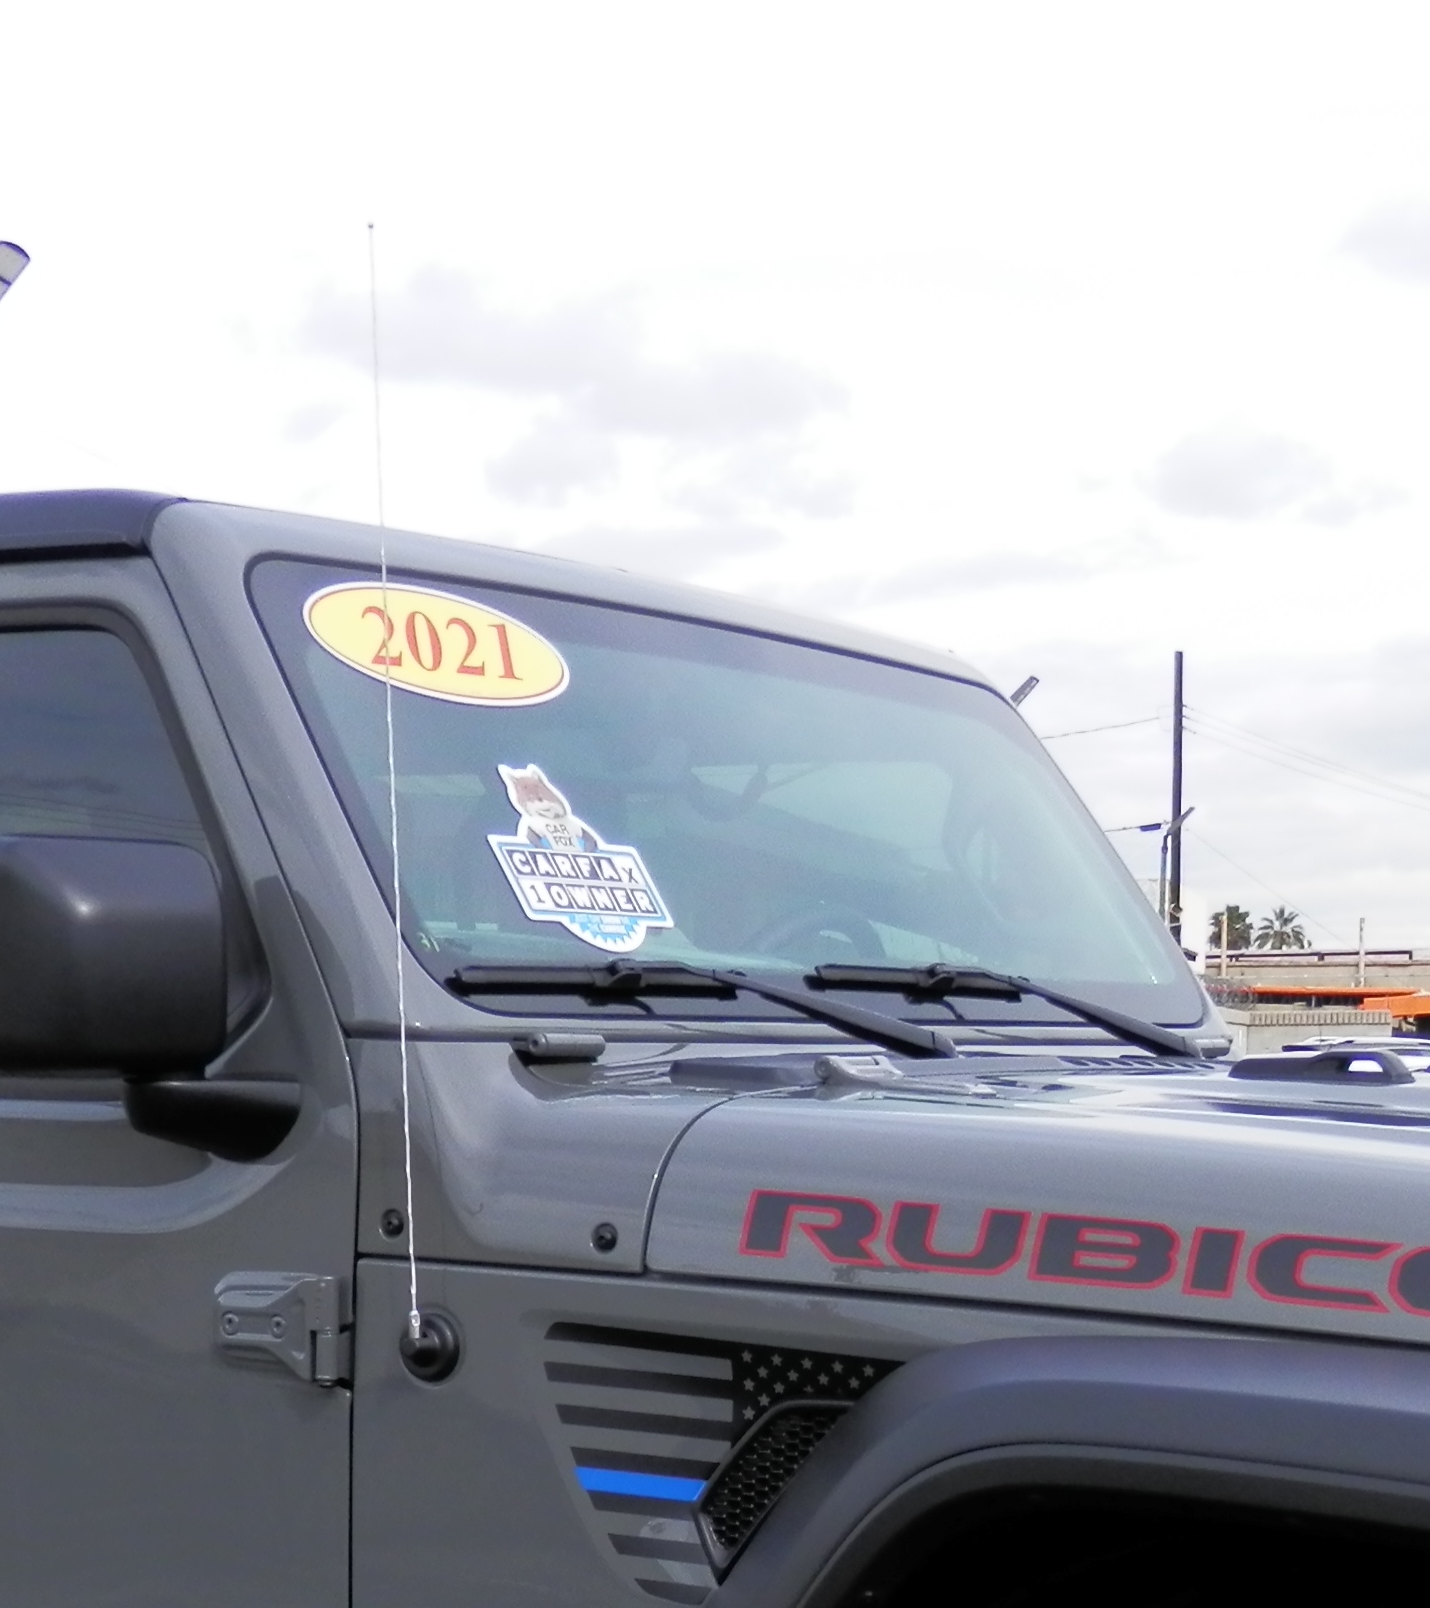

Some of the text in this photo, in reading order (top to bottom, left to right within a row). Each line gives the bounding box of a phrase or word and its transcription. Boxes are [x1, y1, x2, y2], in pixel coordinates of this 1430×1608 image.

[361, 605, 524, 682] 2021
[544, 823, 570, 835] CAR
[552, 834, 577, 848] FOX
[510, 851, 639, 884] CARFAX
